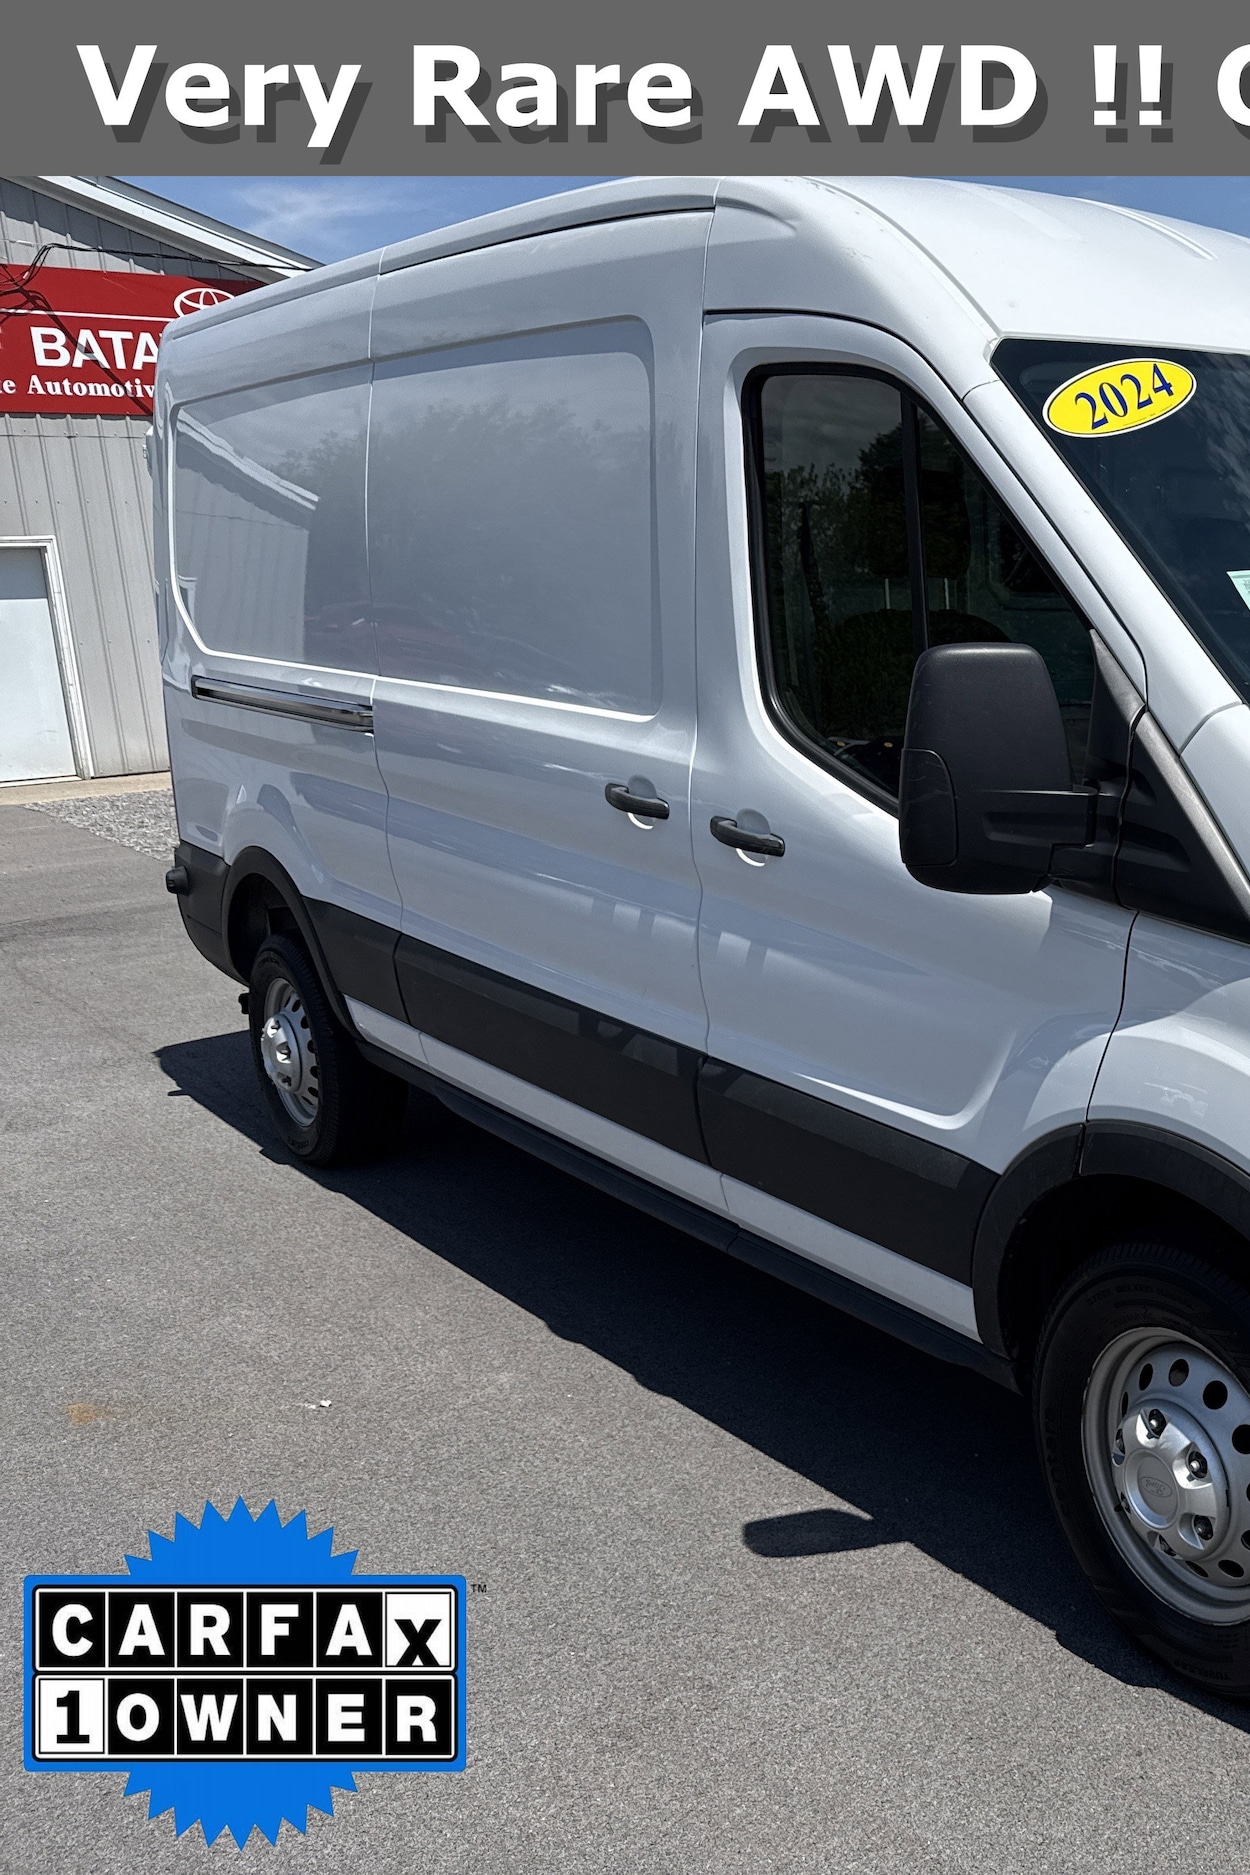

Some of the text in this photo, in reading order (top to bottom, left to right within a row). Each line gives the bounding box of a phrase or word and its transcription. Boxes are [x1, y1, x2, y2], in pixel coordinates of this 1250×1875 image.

[30, 326, 162, 371] BATA
[1074, 363, 1174, 430] 2024
[1144, 1478, 1166, 1496] Ford
